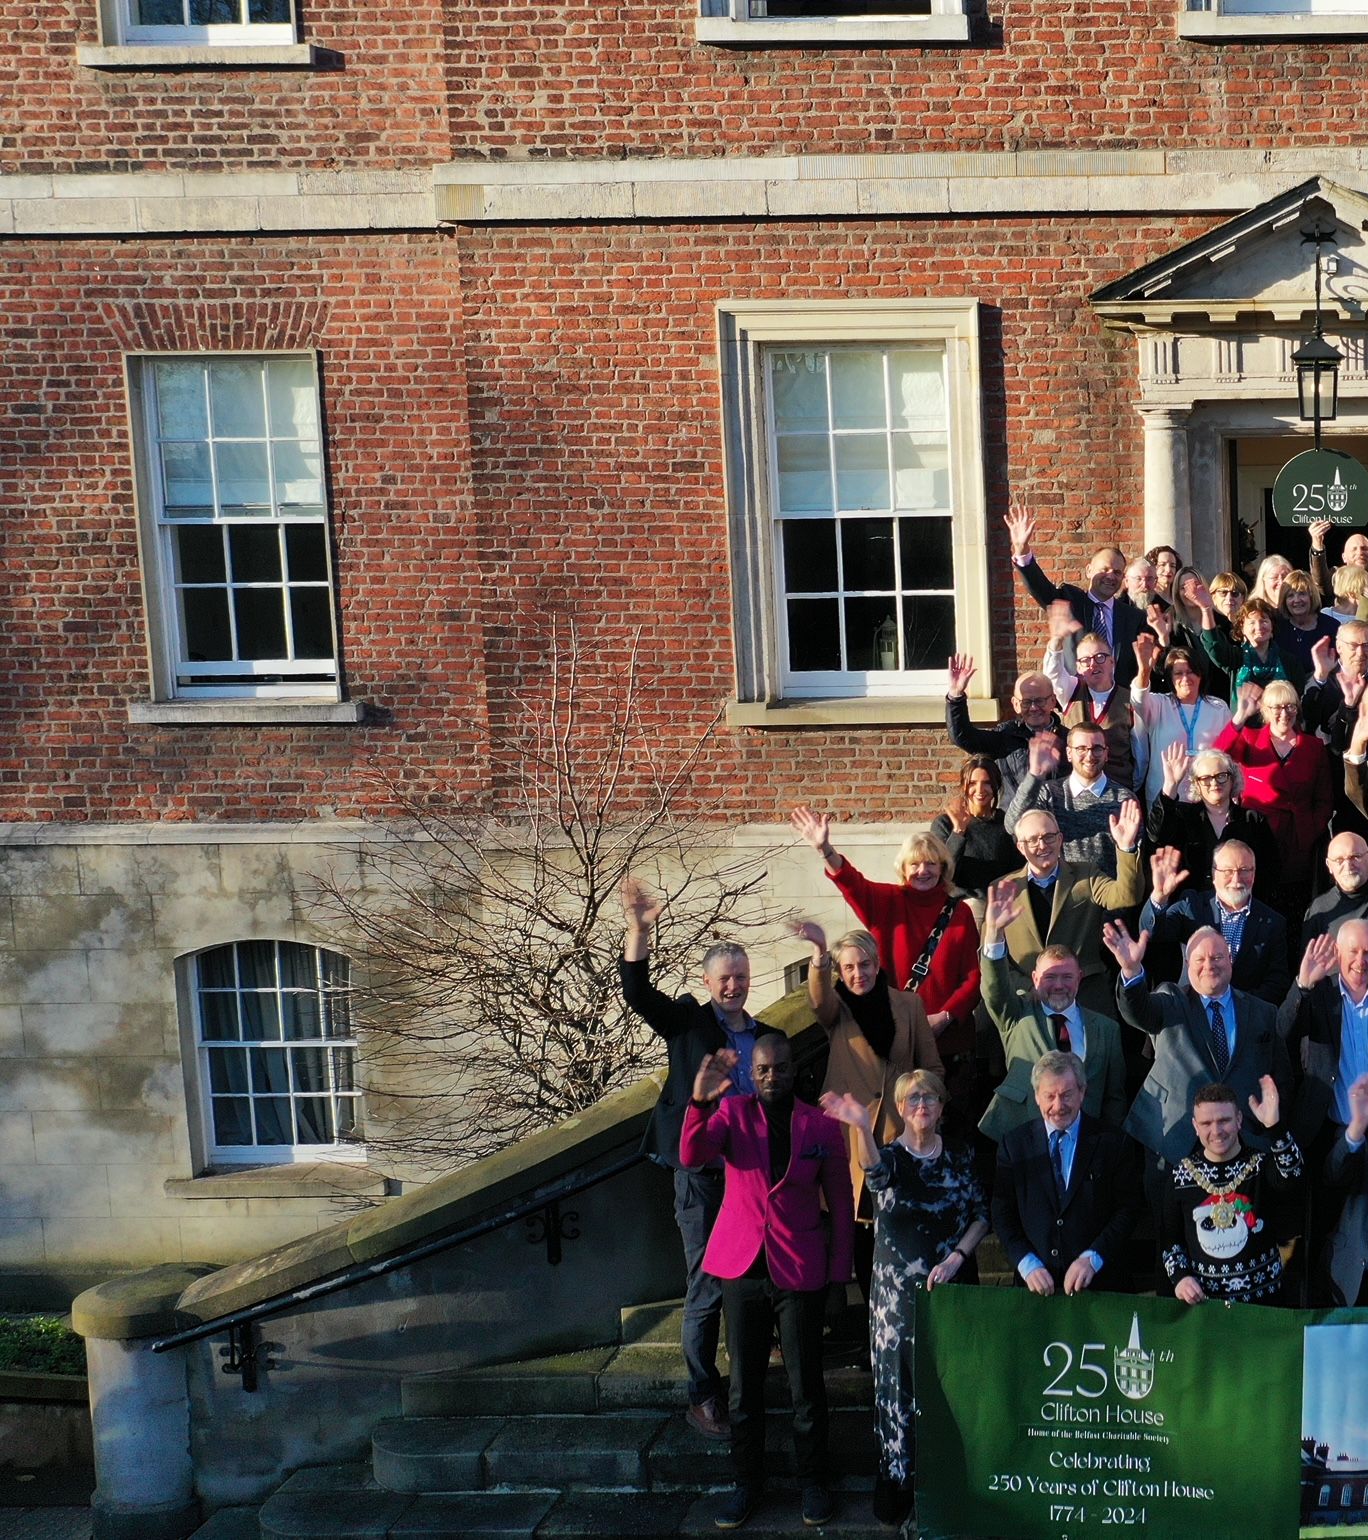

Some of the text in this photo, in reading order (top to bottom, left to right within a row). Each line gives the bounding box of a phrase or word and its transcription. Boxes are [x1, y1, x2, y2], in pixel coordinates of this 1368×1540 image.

[1291, 514, 1353, 524] Clifton House
[1041, 1402, 1164, 1427] Clifton House
[1027, 1428, 1170, 1445] Home of the Belfast Charitable Society
[1049, 1451, 1151, 1473] Celebrating
[988, 1474, 1215, 1501] 250 Years of Clifton House
[1050, 1504, 1084, 1523] 1774
[1101, 1507, 1146, 1524] 2024
